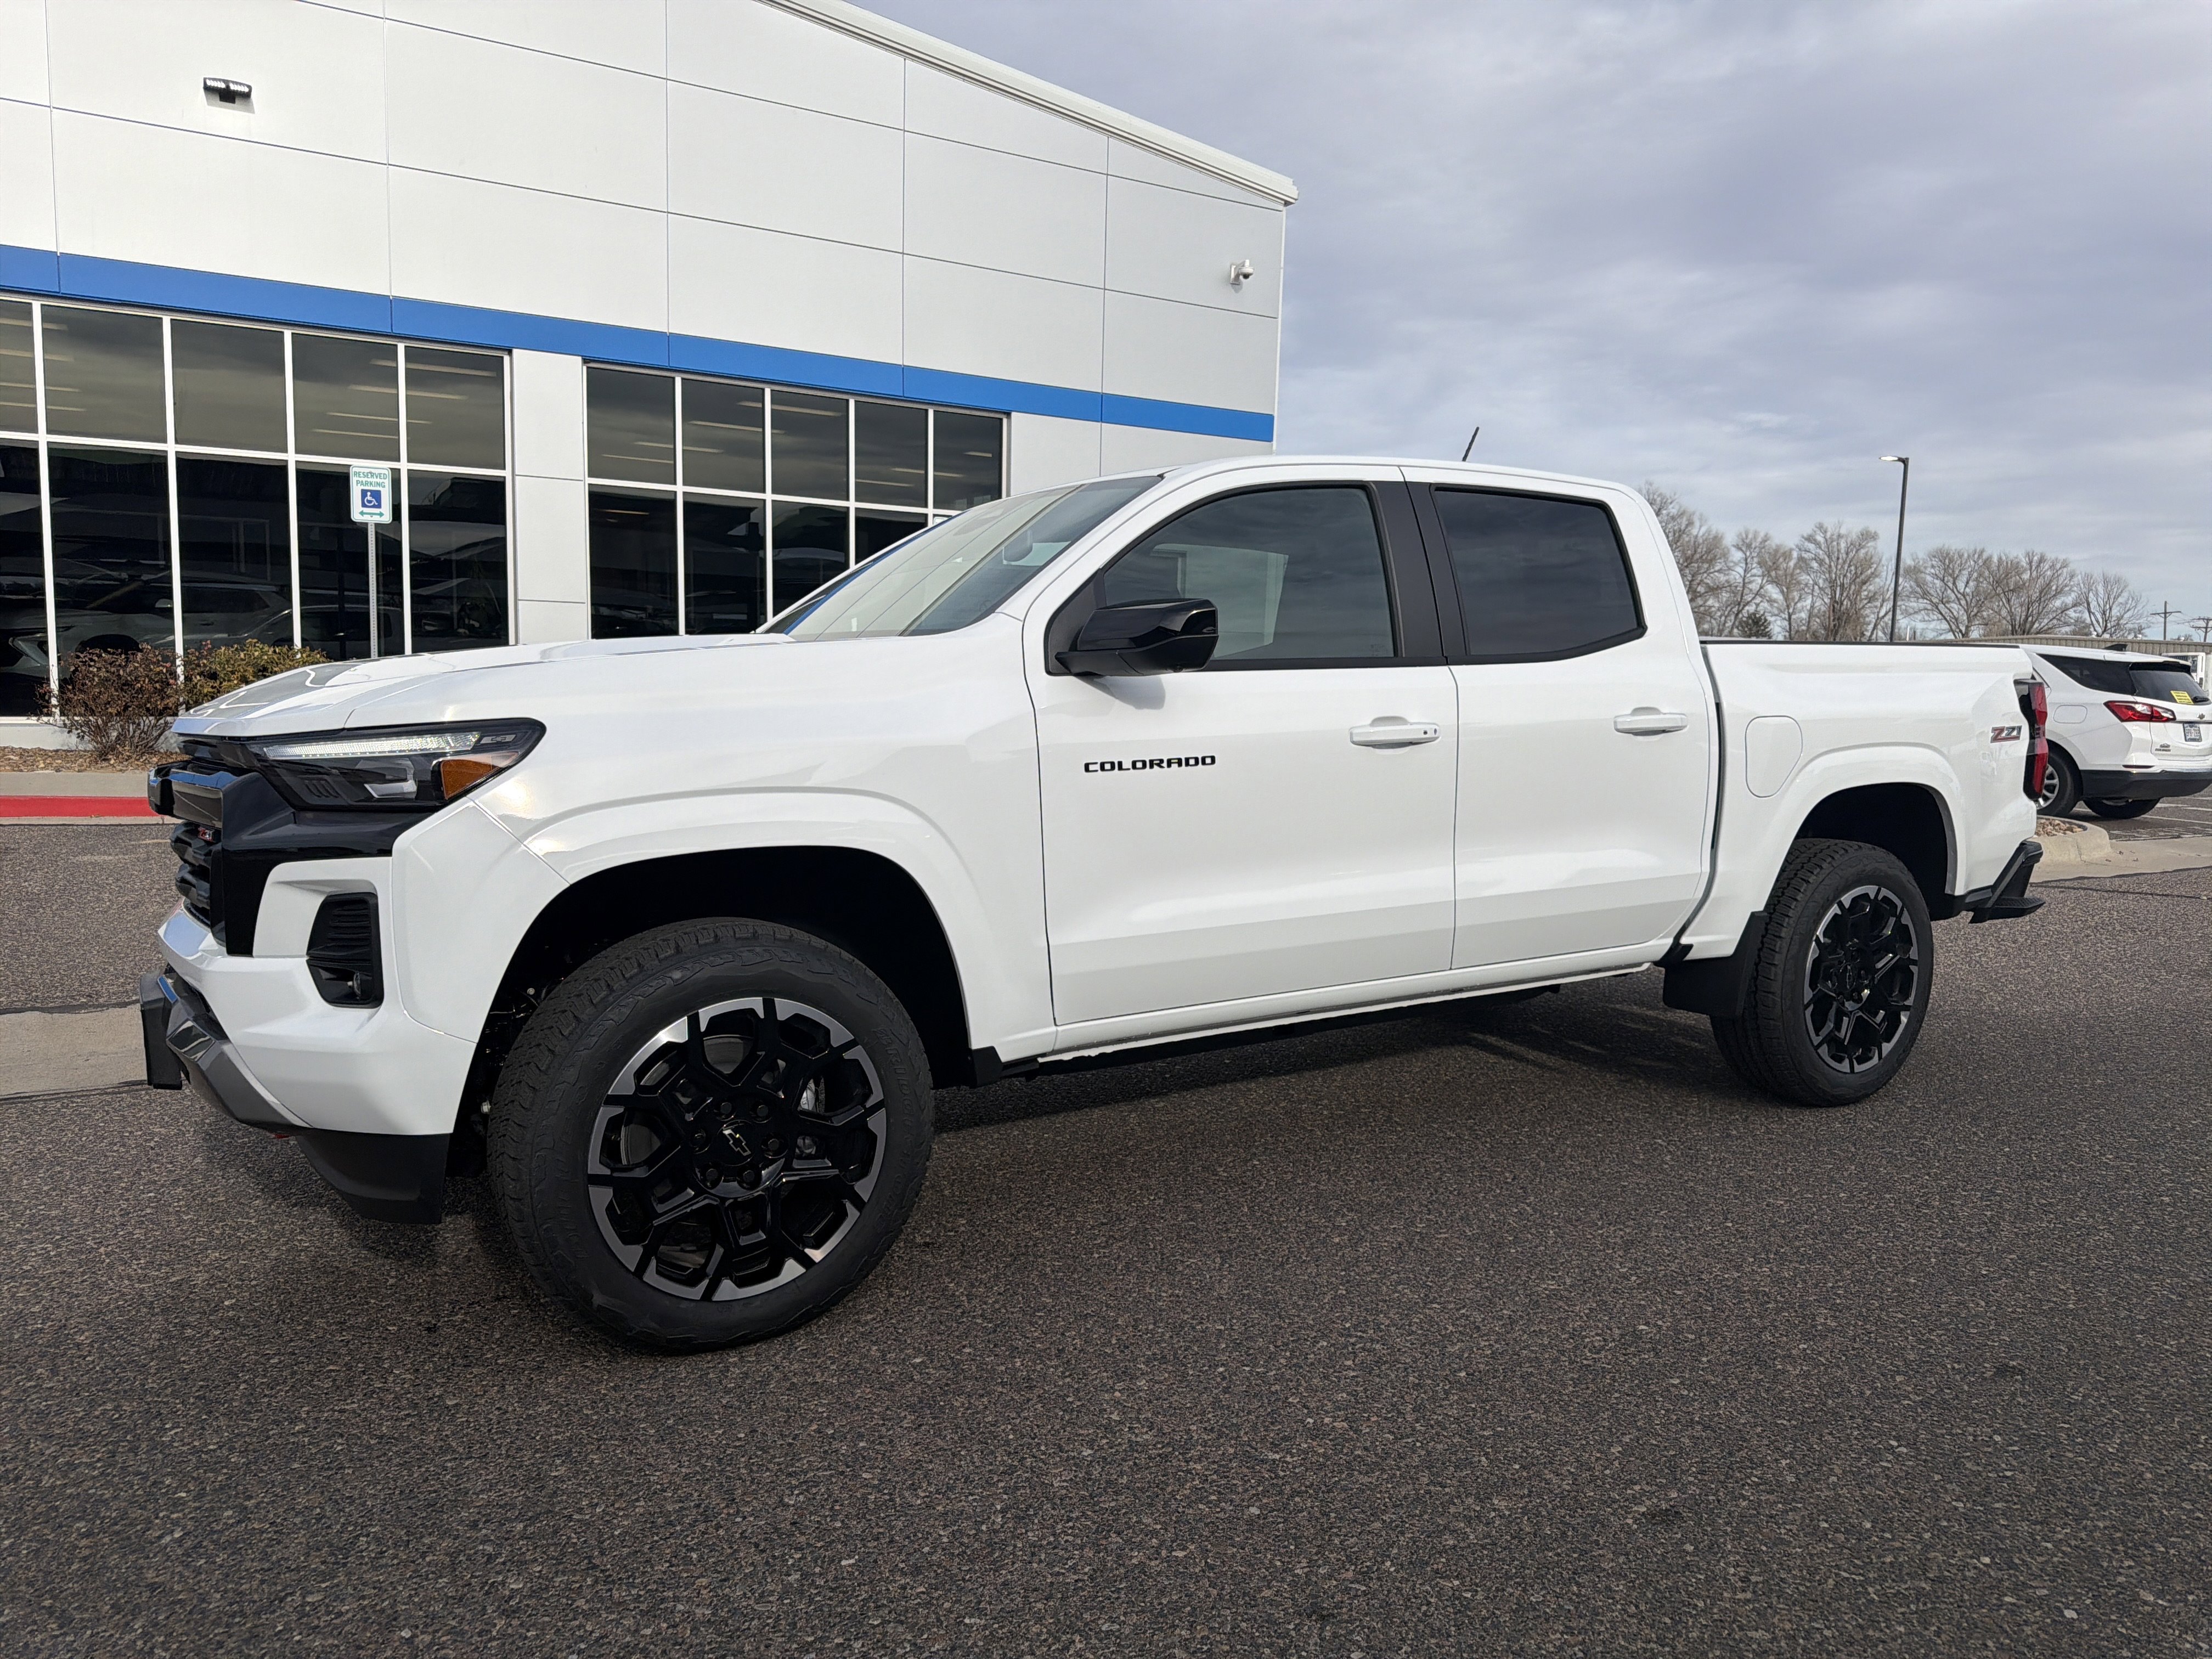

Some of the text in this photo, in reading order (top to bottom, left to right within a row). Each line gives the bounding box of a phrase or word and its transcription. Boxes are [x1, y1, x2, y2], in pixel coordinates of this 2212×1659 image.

[354, 471, 387, 479] RESERVED
[1990, 725, 2022, 743] Z71
[1084, 755, 1216, 772] COLORADO
